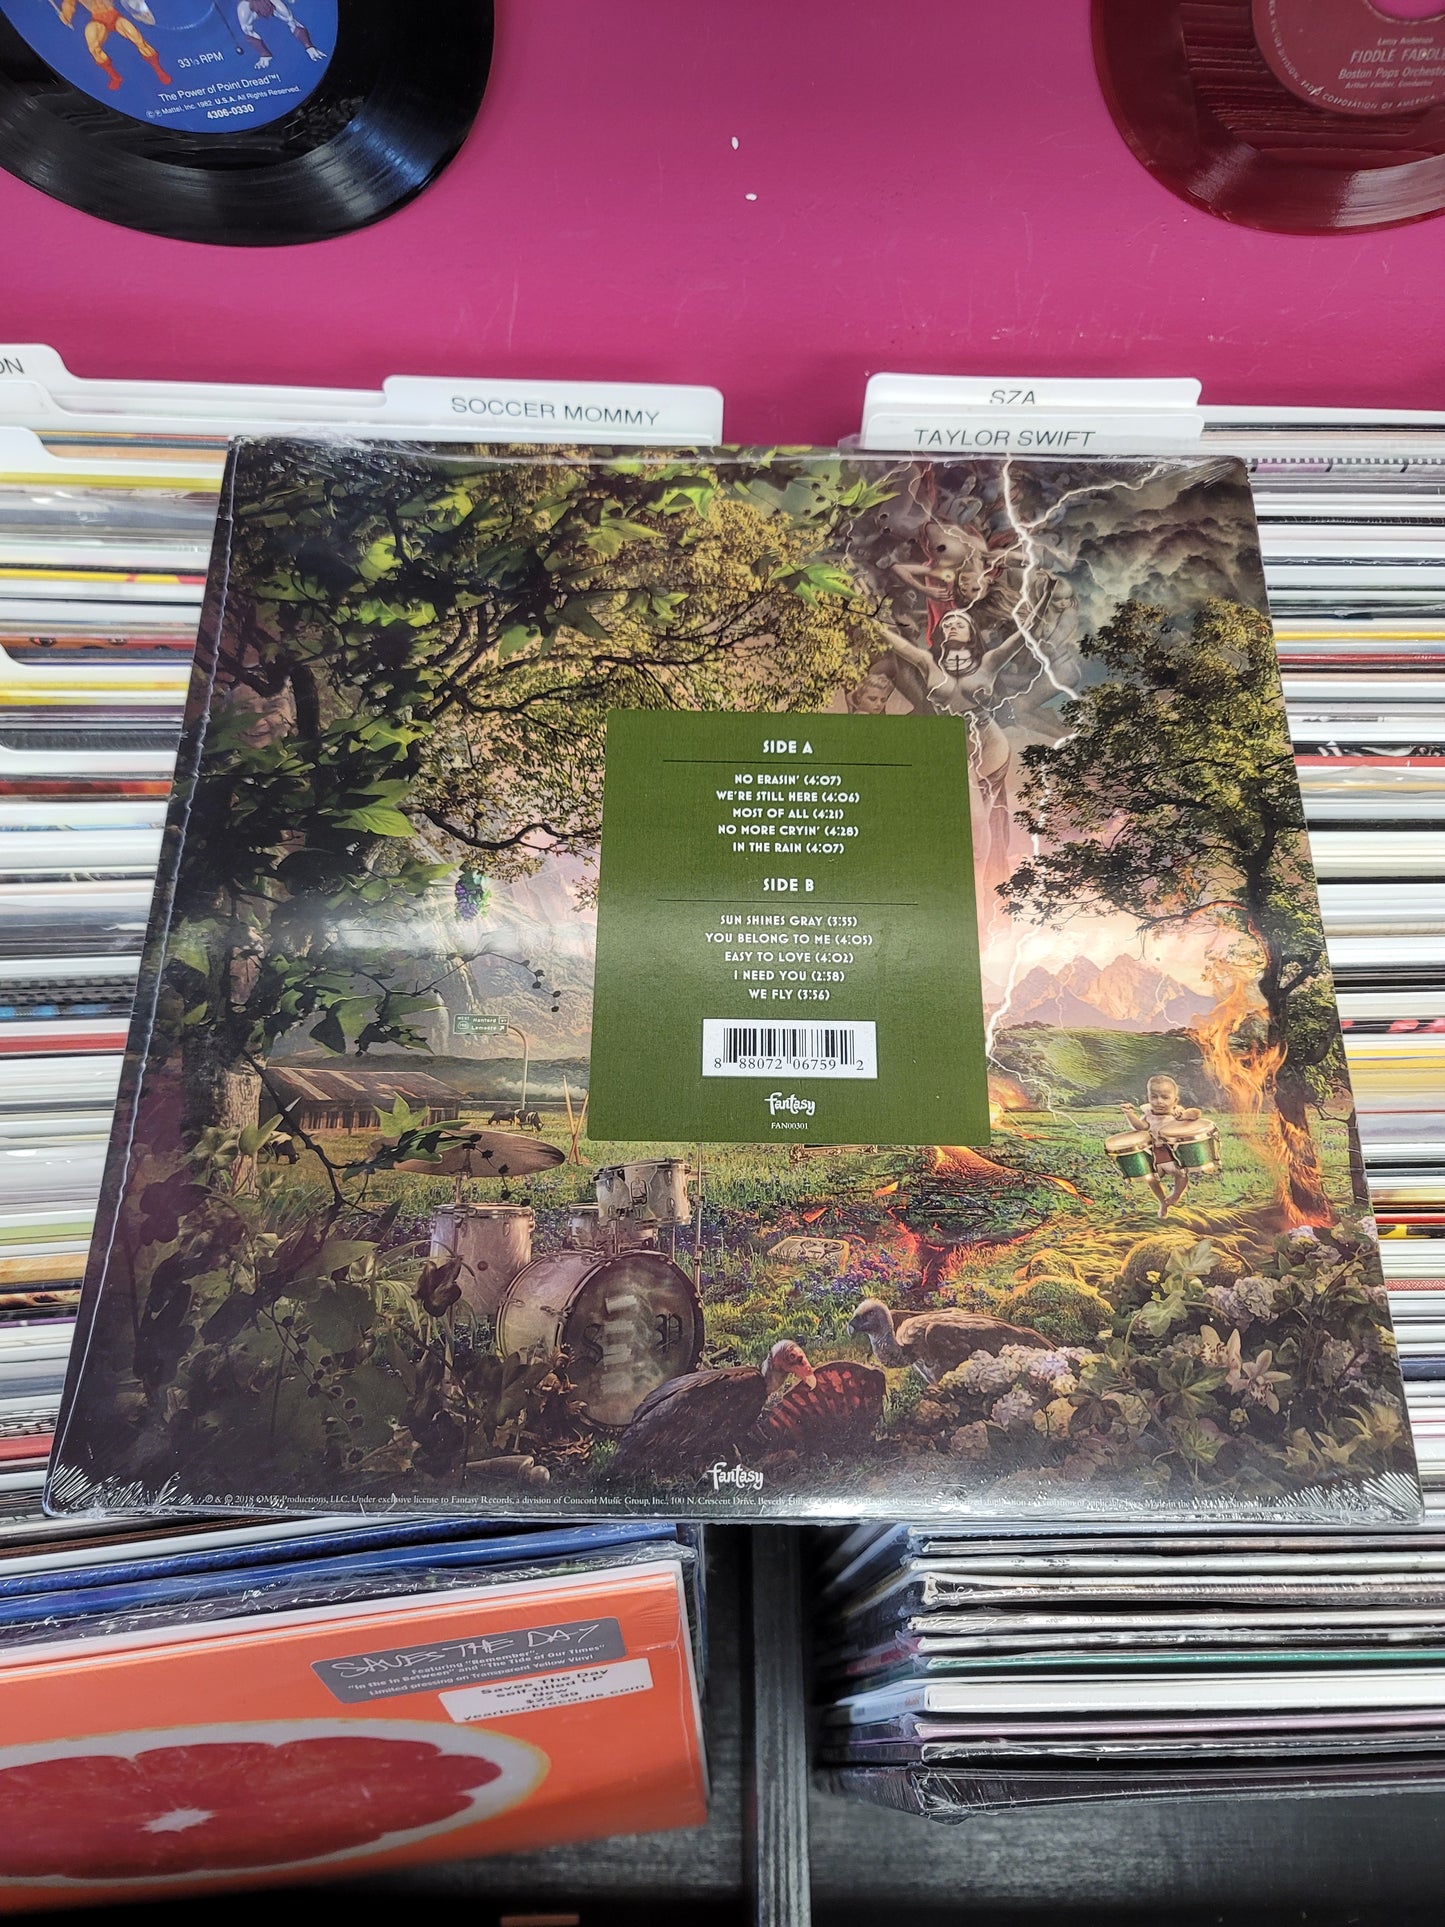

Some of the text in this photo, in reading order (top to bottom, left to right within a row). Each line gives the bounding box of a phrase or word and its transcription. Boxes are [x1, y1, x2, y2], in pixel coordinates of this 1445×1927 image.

[200, 51, 224, 64] RPM
[1350, 49, 1397, 63] FIDDLE
[1338, 68, 1372, 79] Boston
[1375, 67, 1400, 79] Pops
[158, 93, 177, 103] The
[179, 88, 206, 100] Power
[208, 85, 217, 94] of
[217, 81, 242, 92] Point
[215, 96, 236, 105] U.S.A.
[238, 93, 247, 101] All
[247, 90, 268, 101] Rights
[268, 85, 301, 96] Reserved.
[989, 390, 1036, 405] SZA
[451, 397, 660, 426] SOCCER MOMMY
[914, 429, 1096, 447] TAYLOR SWIFT
[763, 740, 812, 753] SIDE A
[735, 774, 841, 785] NO ERASIN' (4:07)
[716, 791, 859, 803] WE'RE STILL HERE (4:06)
[733, 808, 843, 819] MOST OF ALL (4:21)
[719, 825, 858, 836] NO MORE CRYIN' (4:28)
[733, 842, 844, 853] IN THE RAIN (4:07)
[764, 878, 814, 891] SIDE B
[721, 915, 857, 926] SUN SHINES GRAY (3:55)
[706, 933, 872, 945] YOU BELONG TO ME (4:05)
[725, 952, 853, 963] EASY TO LOVE (4:02)
[735, 970, 844, 981] I NEED YOU (2:58)
[749, 989, 829, 1000] WE FLY (3:56)
[714, 1057, 864, 1072] 8 88072 06759 2
[770, 1121, 810, 1131] FAN00301
[235, 1494, 254, 1503] 2018
[282, 1494, 329, 1504] Productions,
[330, 1495, 350, 1503] LLC.
[351, 1495, 376, 1503] Under
[378, 1494, 411, 1503] exclusive
[414, 1495, 437, 1503] license
[451, 1495, 479, 1505] Fantasy
[481, 1495, 514, 1505] Records,
[522, 1496, 551, 1504] division
[553, 1495, 563, 1504] of
[563, 1496, 597, 1504] Concord
[599, 1496, 622, 1504] Music
[624, 1496, 651, 1506] Group,
[652, 1496, 669, 1505] Inc.,
[671, 1496, 685, 1505] 100
[686, 1497, 698, 1505] N.
[699, 1497, 731, 1505] Crescent
[331, 1623, 600, 1677] SAVES THE DAY
[367, 1680, 387, 1688] the
[458, 1665, 478, 1673] and
[508, 1656, 532, 1664] Tide
[534, 1653, 545, 1661] of
[549, 1650, 566, 1658] Our
[411, 1661, 463, 1675] Featuring
[369, 1685, 408, 1697] Limited
[456, 1674, 470, 1682] on
[471, 1665, 531, 1678] Transparent
[532, 1658, 566, 1669] Yellow
[567, 1654, 594, 1663] Vinyl
[481, 1668, 609, 1694] Saves The Day
[582, 1675, 604, 1684] LP
[532, 1688, 568, 1697] New
[464, 1684, 646, 1721] yearbookrecords.com
